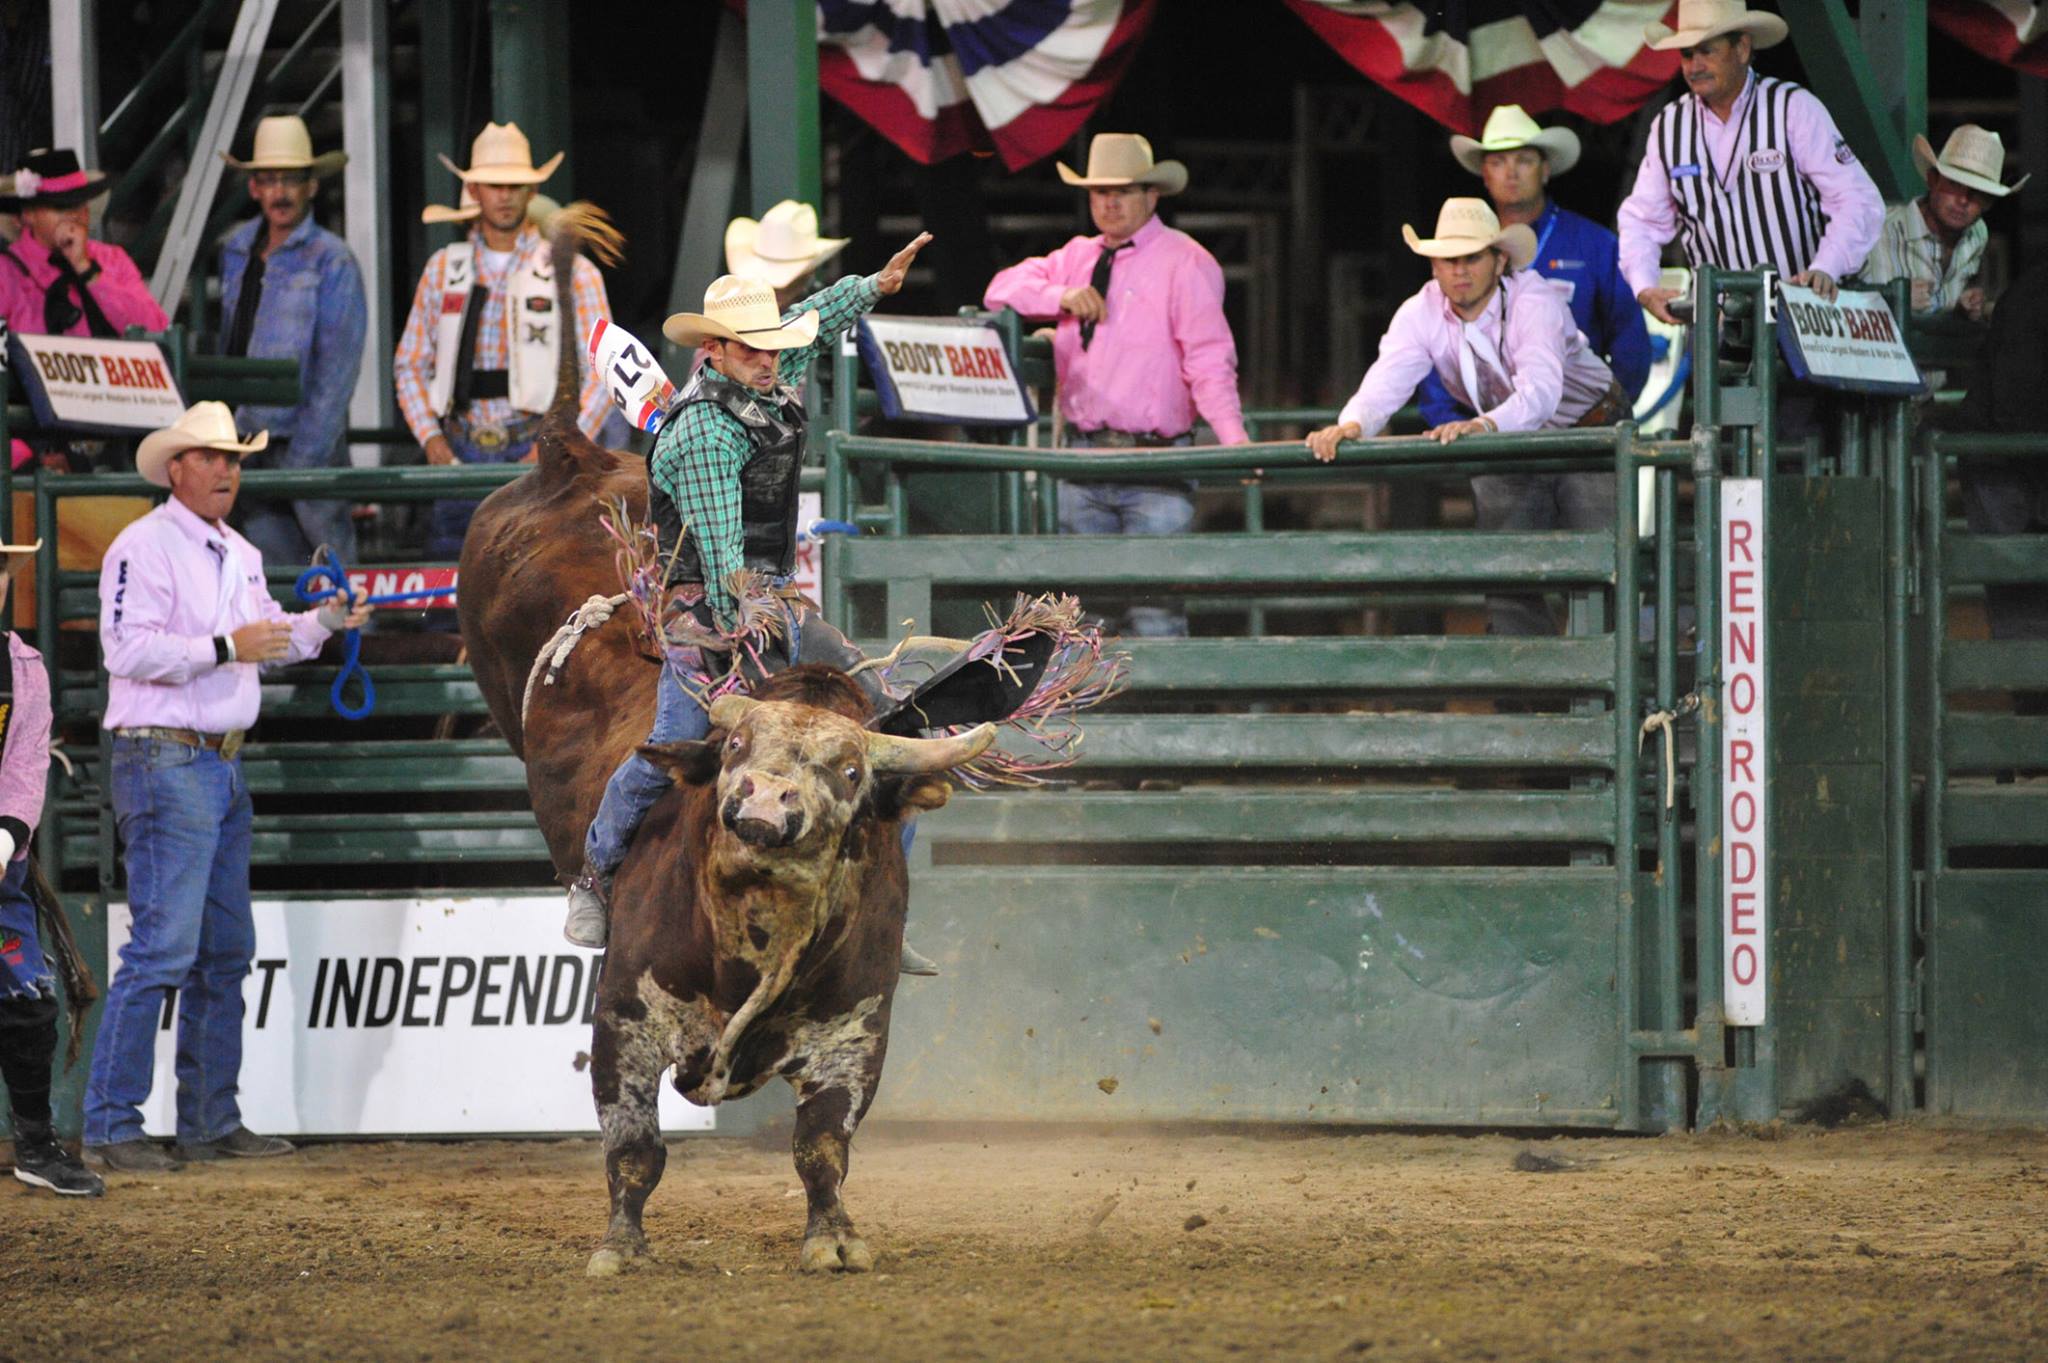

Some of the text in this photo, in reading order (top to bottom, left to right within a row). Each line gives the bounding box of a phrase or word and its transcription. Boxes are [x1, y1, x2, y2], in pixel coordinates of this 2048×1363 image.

[1789, 302, 1897, 343] BOOT BARN
[36, 351, 169, 391] BOOT BARN
[884, 341, 1008, 380] BOOT BARN
[1729, 520, 1757, 985] RENO RODEO
